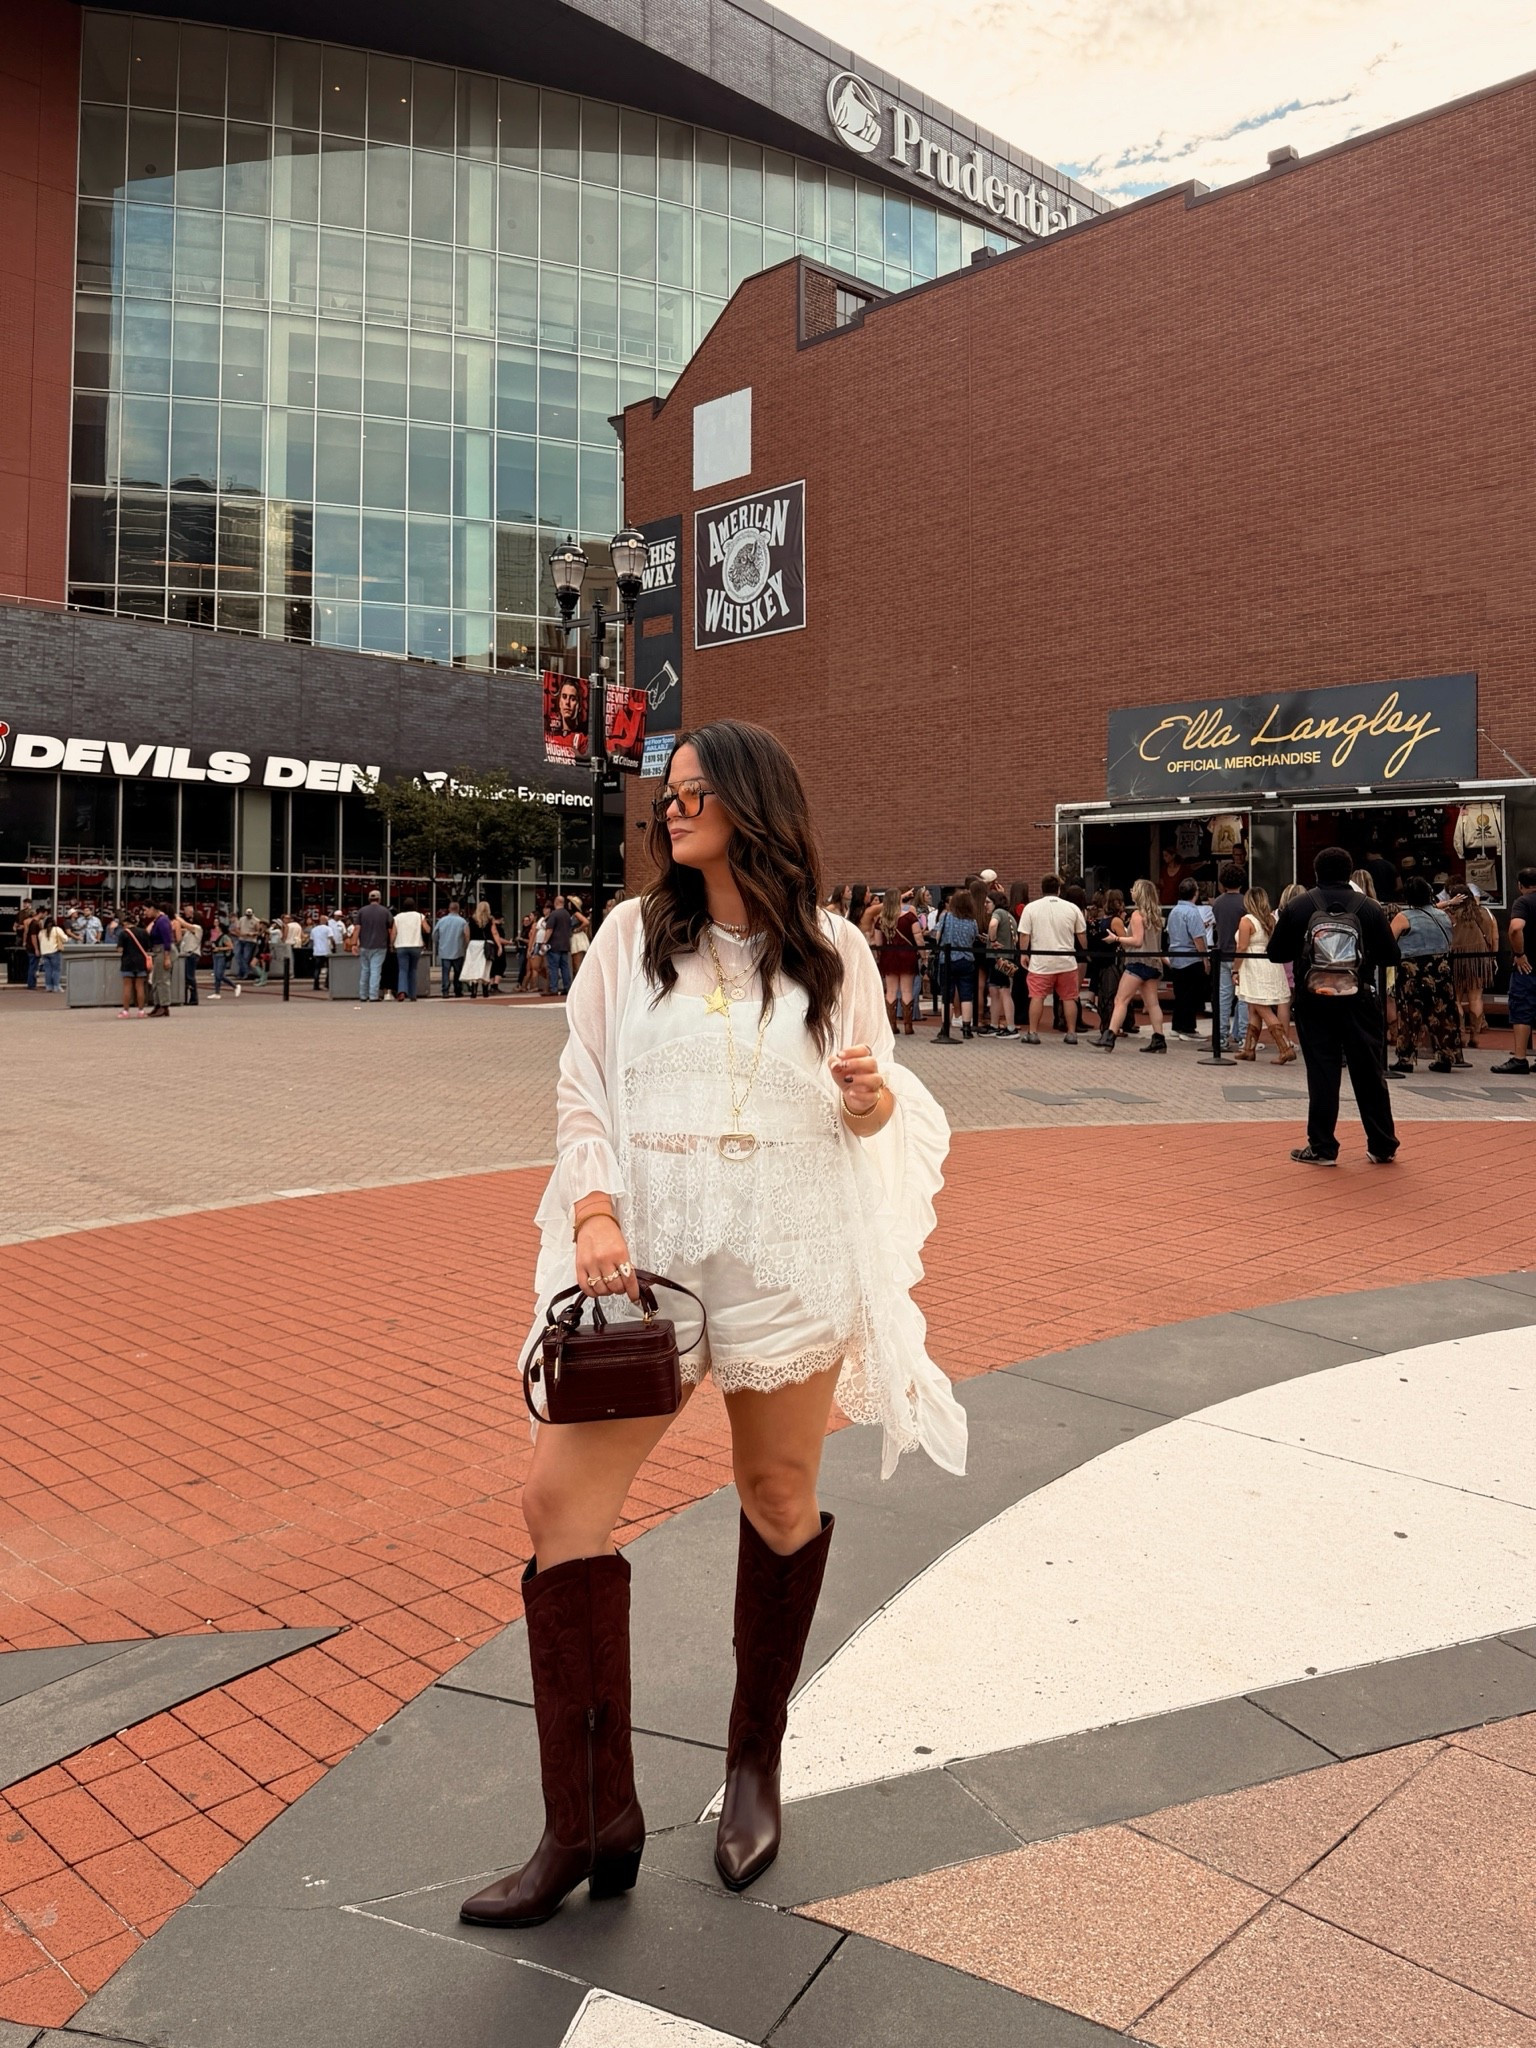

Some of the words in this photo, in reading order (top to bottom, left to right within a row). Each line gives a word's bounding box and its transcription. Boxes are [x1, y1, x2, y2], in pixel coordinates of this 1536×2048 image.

[708, 499, 790, 567] AMERICAN
[641, 562, 676, 590] WAY
[705, 569, 790, 634] WHISKEY
[606, 691, 629, 704] DEVILS
[1139, 707, 1241, 761] Ella
[1251, 691, 1441, 779] Langley
[11, 733, 251, 784] DEVILS
[263, 756, 381, 794] DEN
[1167, 757, 1222, 773] OFFICIAL
[1224, 751, 1321, 769] MERCHANDISE
[518, 786, 594, 807] Experienc
